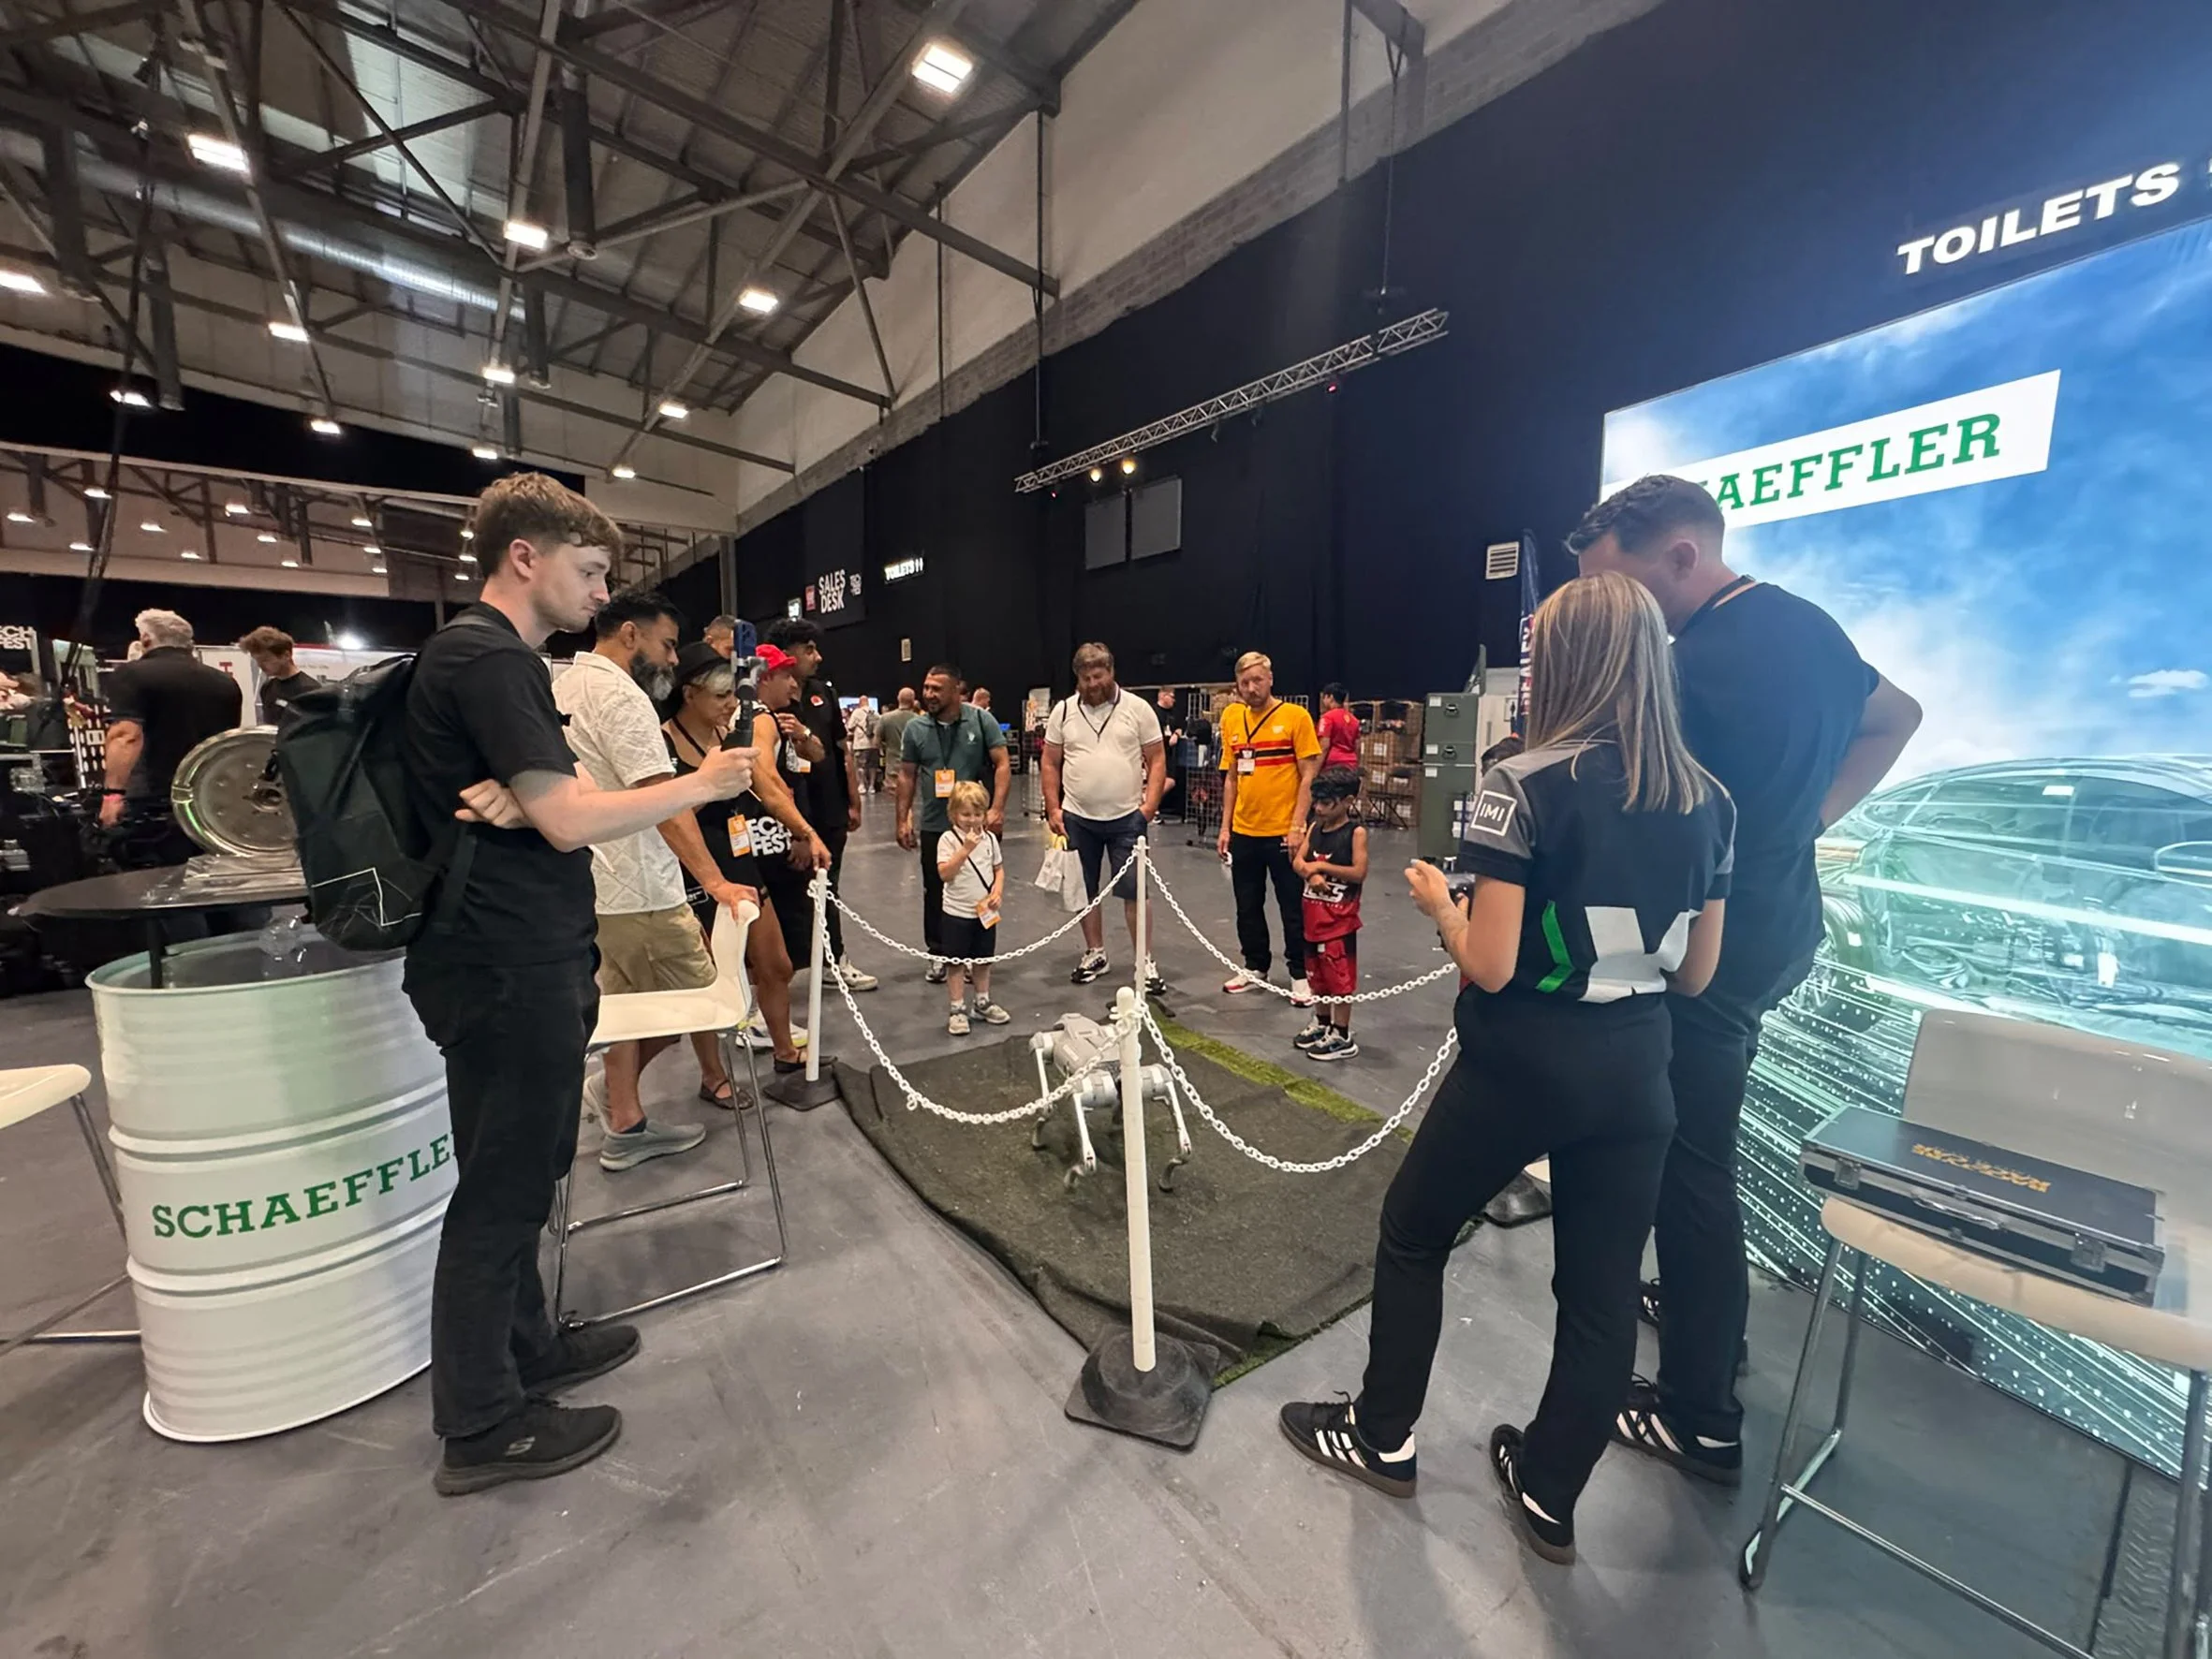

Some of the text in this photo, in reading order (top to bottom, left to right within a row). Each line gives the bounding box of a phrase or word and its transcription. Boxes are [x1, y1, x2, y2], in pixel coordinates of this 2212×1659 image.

[1897, 162, 2181, 274] TOILETS
[1697, 413, 2000, 510] AEFFLER
[818, 568, 846, 595] SALES
[820, 589, 845, 613] DESK
[0, 625, 36, 638] CH
[1480, 802, 1505, 821] IMI
[152, 1130, 456, 1238] SCHAEFFLE
